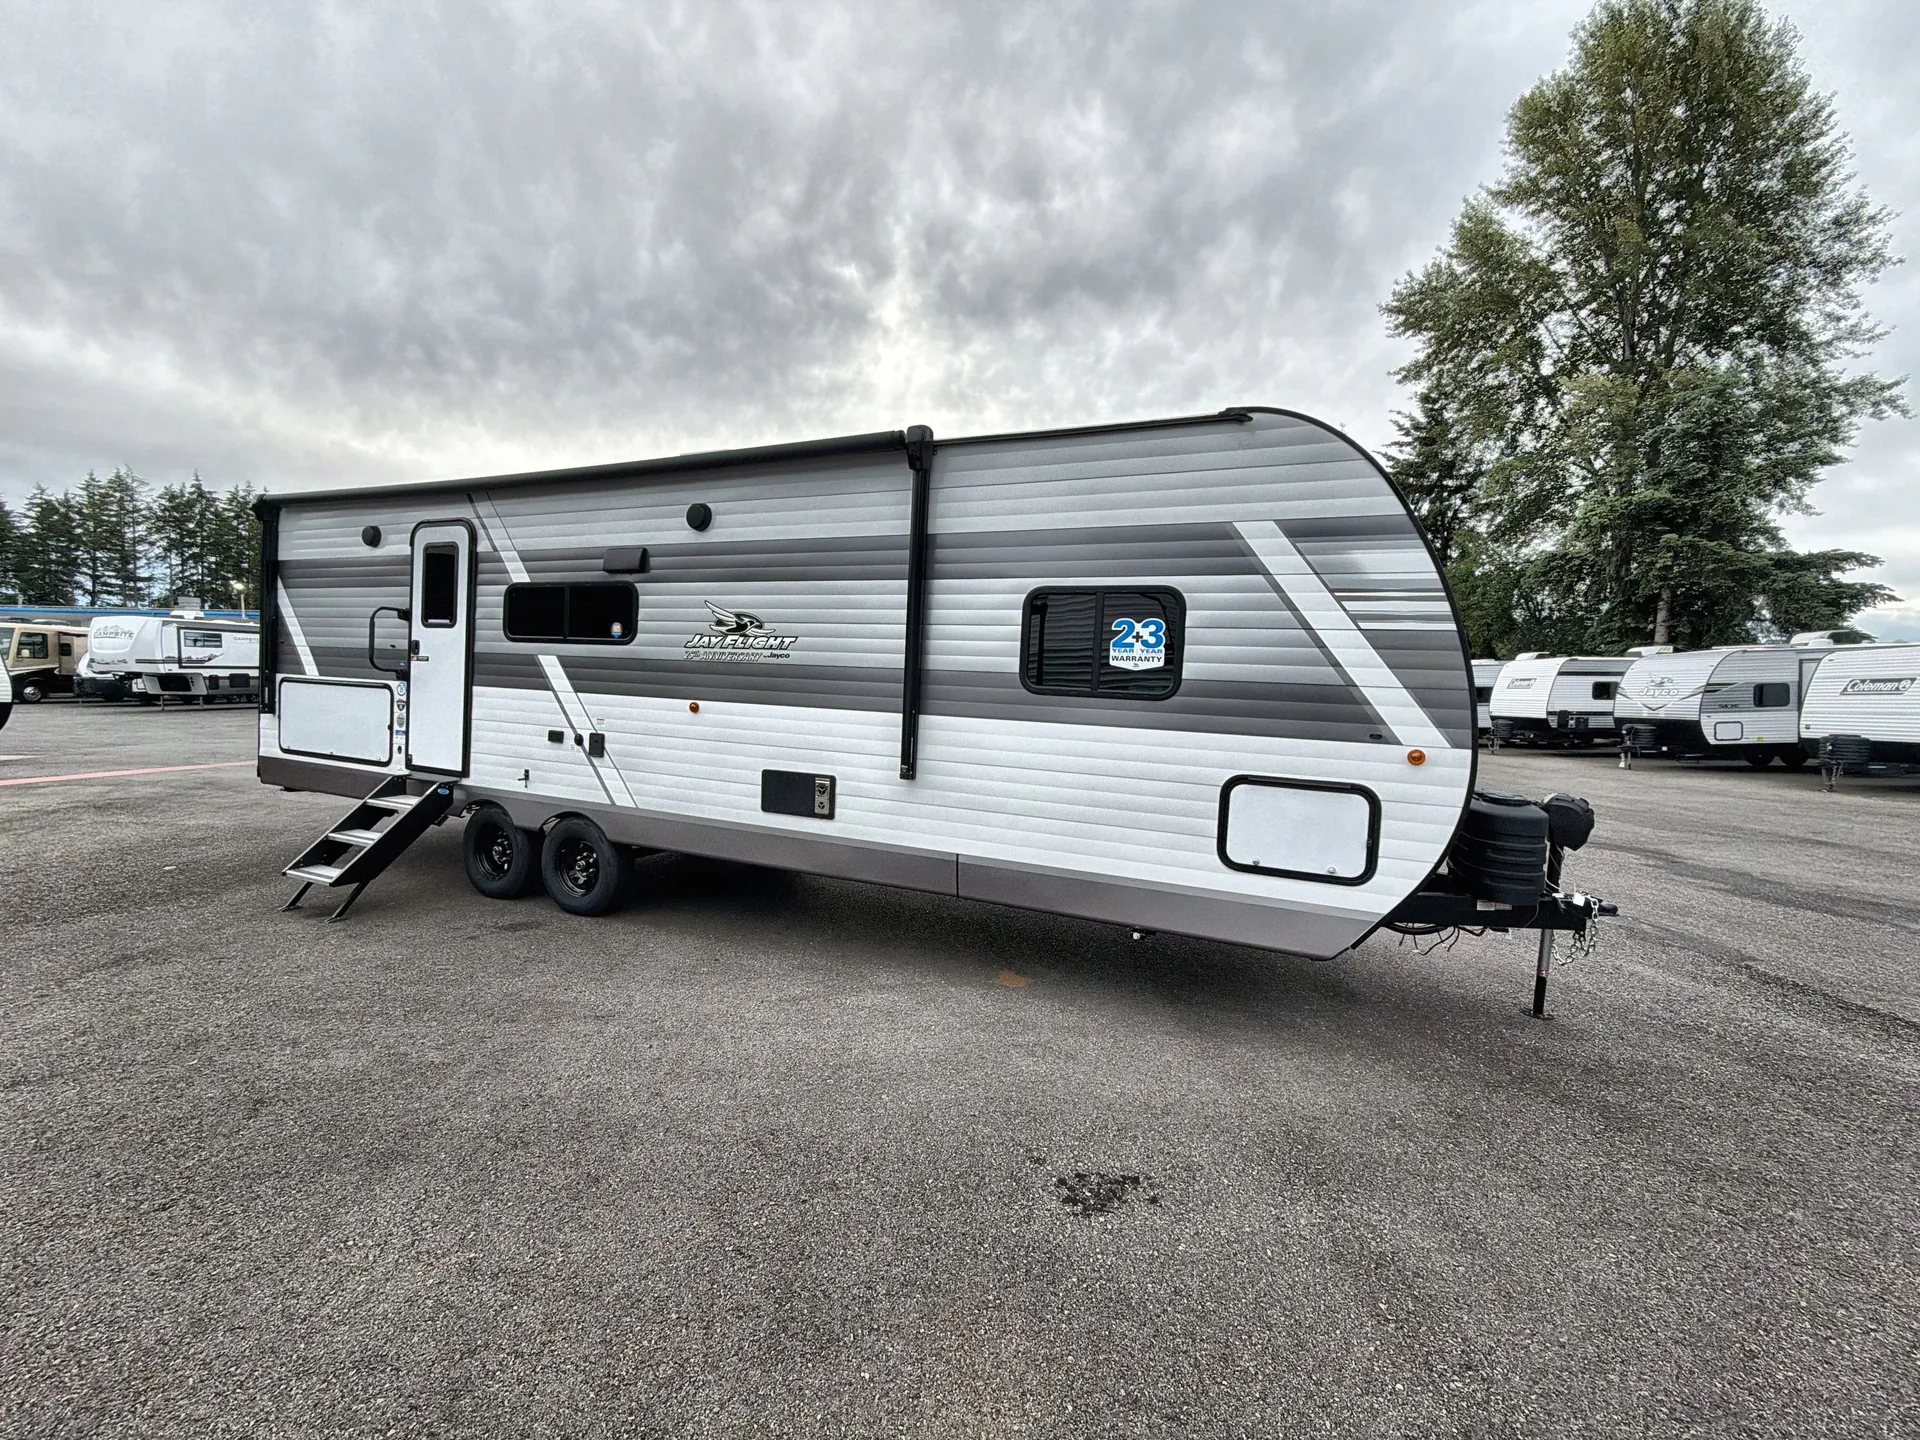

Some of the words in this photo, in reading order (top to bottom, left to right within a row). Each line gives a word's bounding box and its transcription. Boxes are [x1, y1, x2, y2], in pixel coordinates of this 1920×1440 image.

[699, 651, 763, 662] ANNIVERSARY
[1111, 655, 1163, 663] WARRANTY
[1847, 680, 1899, 691] Coleman
[1638, 687, 1679, 698] Jayco
